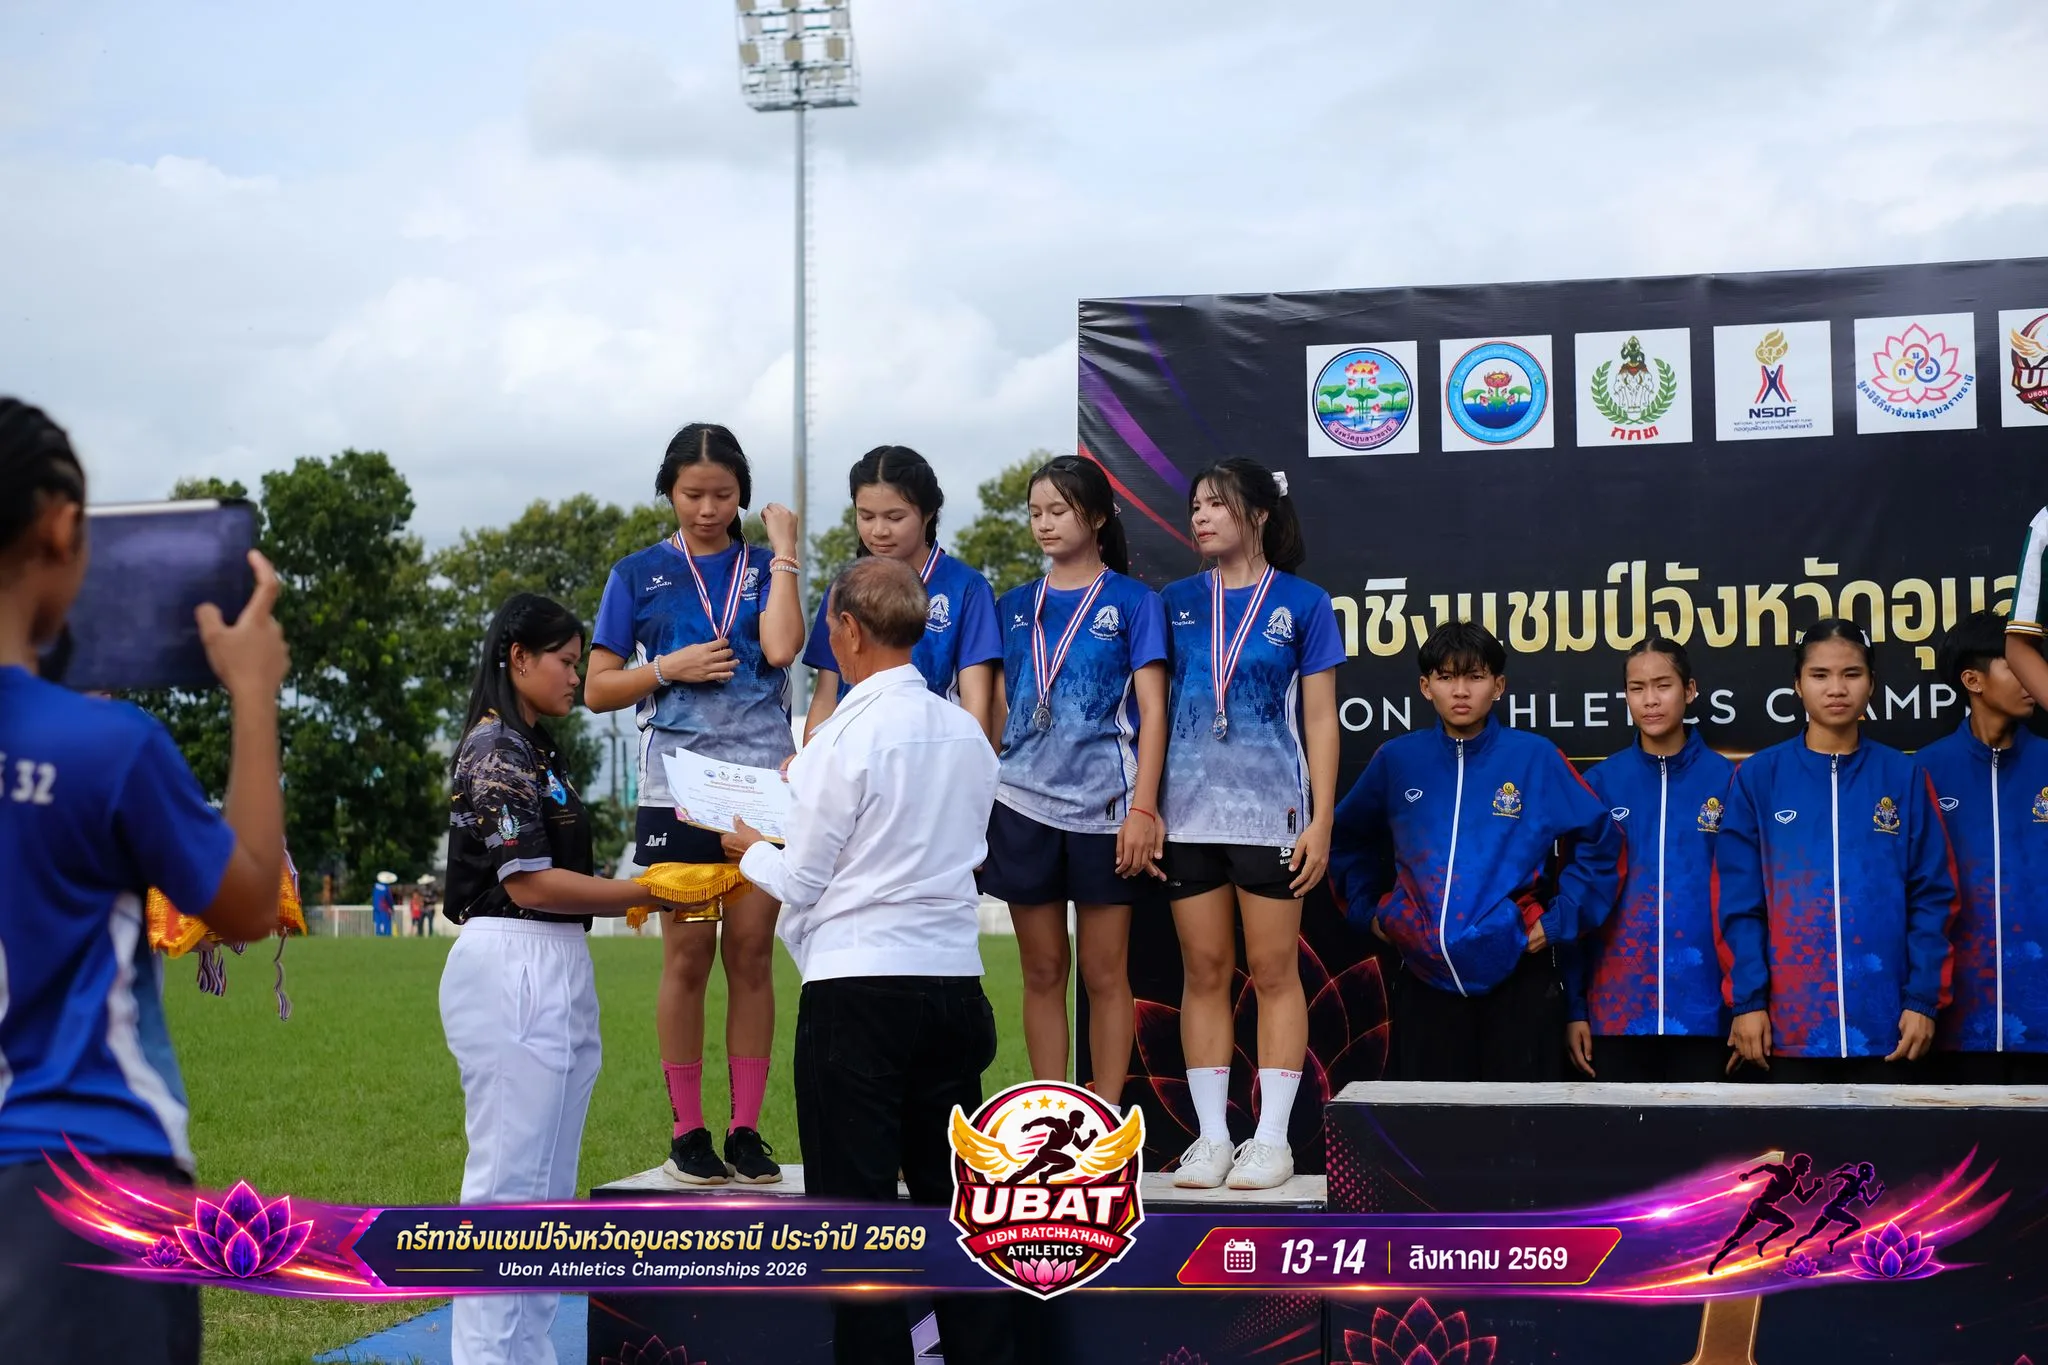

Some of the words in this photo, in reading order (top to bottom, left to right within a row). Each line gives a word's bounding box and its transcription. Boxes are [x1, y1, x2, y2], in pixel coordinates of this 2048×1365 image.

[1749, 406, 1797, 419] NSDF
[1339, 696, 1412, 732] ON
[645, 832, 668, 847] Ari
